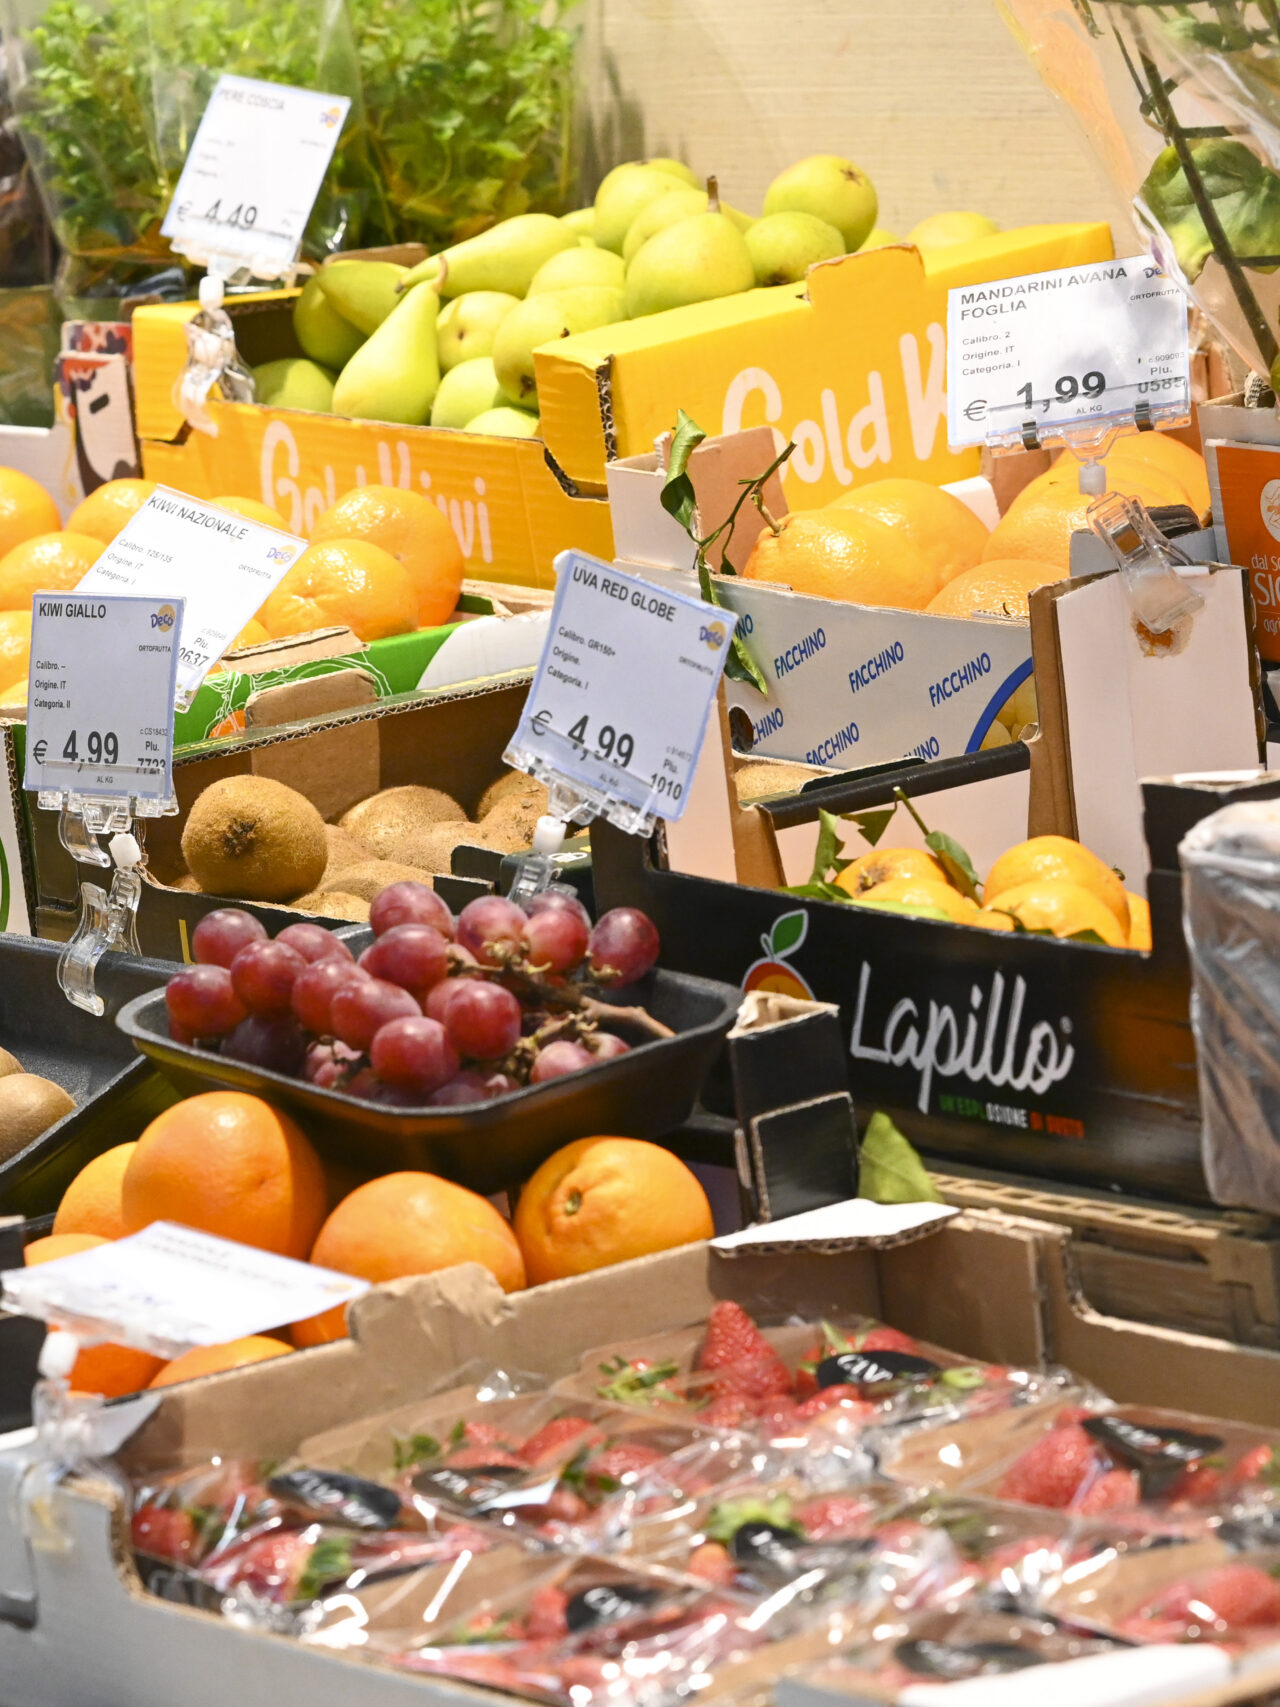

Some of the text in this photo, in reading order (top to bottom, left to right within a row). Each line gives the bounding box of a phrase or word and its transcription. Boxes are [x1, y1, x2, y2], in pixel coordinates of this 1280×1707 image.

[960, 266, 1128, 305] MANDARINI AVANA
[1130, 288, 1181, 301] ORTOFRUTTA
[960, 299, 1027, 321] FOGLIA
[962, 331, 1011, 346] Calibro. 2
[962, 345, 1015, 361] Origine. IT
[962, 362, 1015, 376] Categoria.
[963, 371, 1106, 422] € 1,99
[1089, 404, 1103, 413] KG
[147, 496, 249, 540] KIWI NAZIONALE
[1251, 553, 1268, 572] dal
[572, 566, 677, 622] UVA RED GLOBE
[39, 603, 107, 618] KIWI GIALLO
[774, 628, 826, 679] FACCHINO
[35, 661, 60, 670] Calibro.
[849, 641, 904, 694] FACCHINO
[35, 680, 67, 691] Origine. IT
[928, 652, 991, 708] FACCHINO
[34, 698, 65, 709] Categoria.
[145, 741, 159, 751] Plu.
[529, 710, 635, 769] € 4,99
[33, 729, 119, 773] € 4,99
[650, 772, 683, 800] 1010
[850, 960, 1075, 1115] Lapillo
